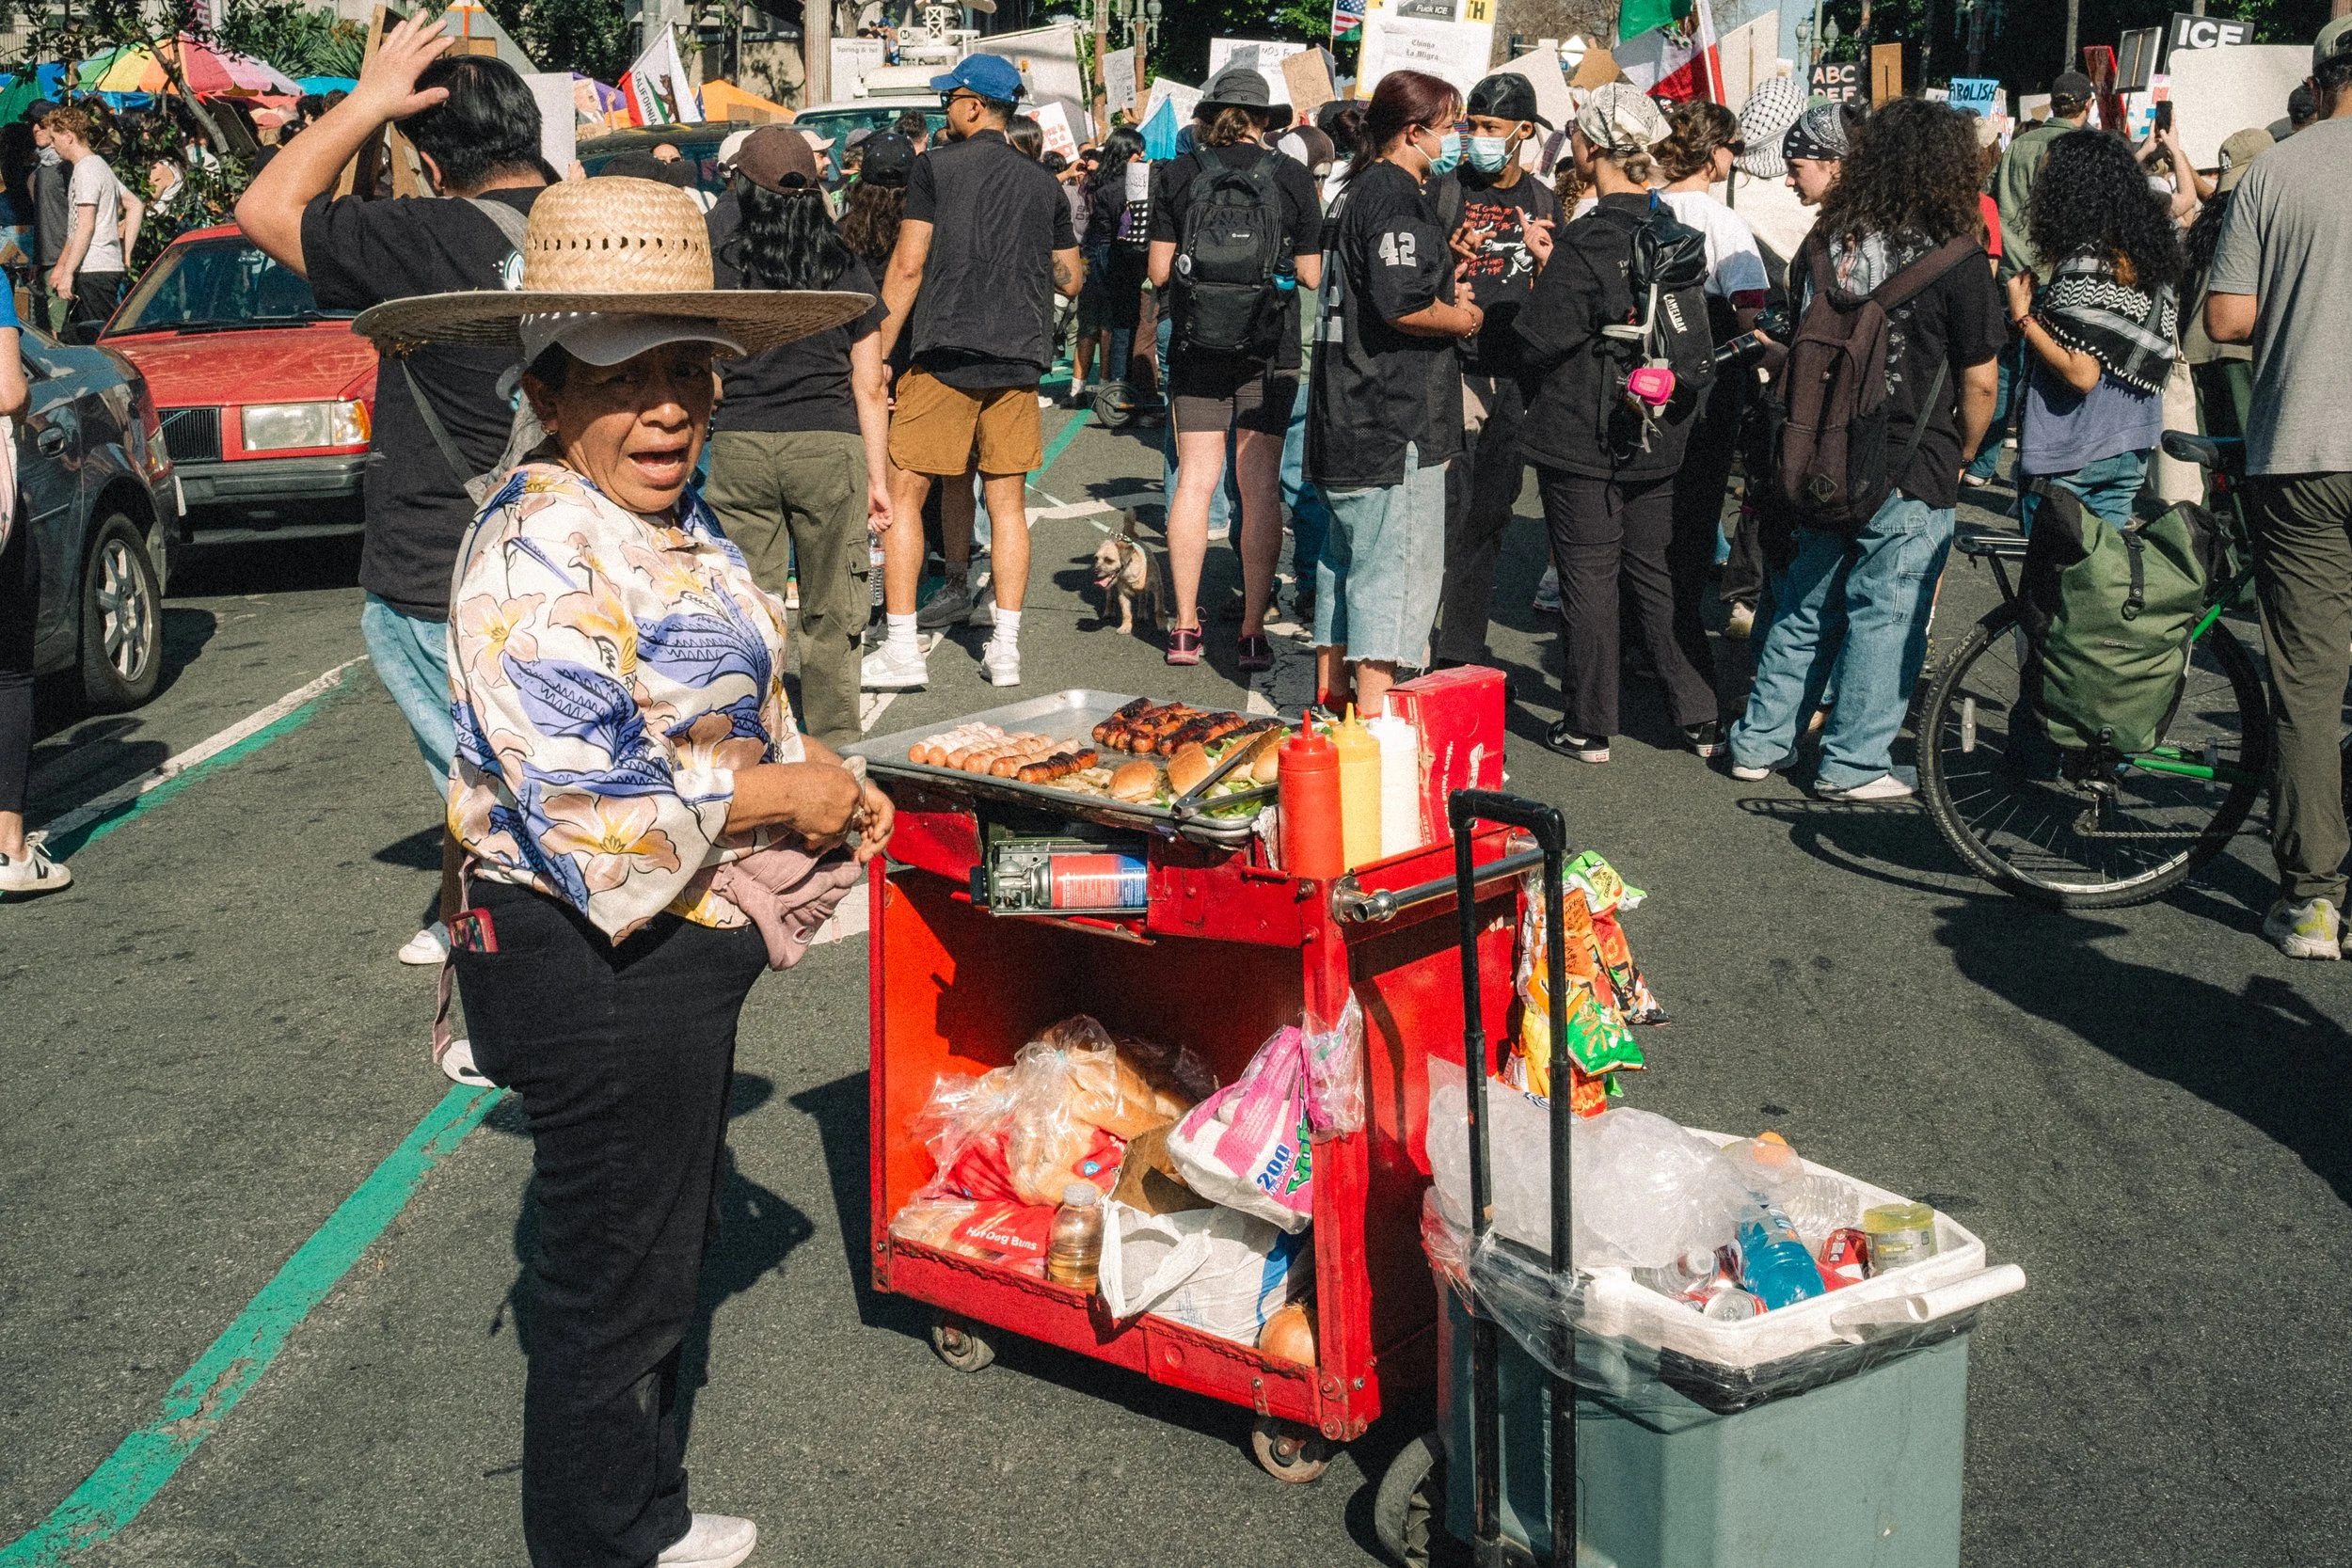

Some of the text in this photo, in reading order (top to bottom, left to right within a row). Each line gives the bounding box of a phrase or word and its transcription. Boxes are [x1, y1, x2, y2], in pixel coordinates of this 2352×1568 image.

[1415, 4, 1449, 15] Fuck ICE
[1411, 39, 1436, 50] Chinga
[2178, 19, 2244, 48] ICE
[836, 45, 859, 55] Spring
[1406, 48, 1438, 60] La Migra
[1812, 64, 1855, 85] ABC
[634, 71, 658, 126] CALIFORNIA
[1948, 83, 1996, 102] ABOLISH
[1378, 231, 1417, 267] 42
[1662, 293, 1688, 334] CAMELBAK
[1441, 772, 1450, 802] Value
[1937, 809, 1977, 859] CONTINENTAL
[2048, 869, 2157, 894] INFERNO
[1256, 1143, 1291, 1191] 200
[1268, 1150, 1295, 1197] Napkins
[965, 1226, 986, 1238] Hot
[986, 1230, 1009, 1246] Dog
[1010, 1236, 1038, 1251] Buns
